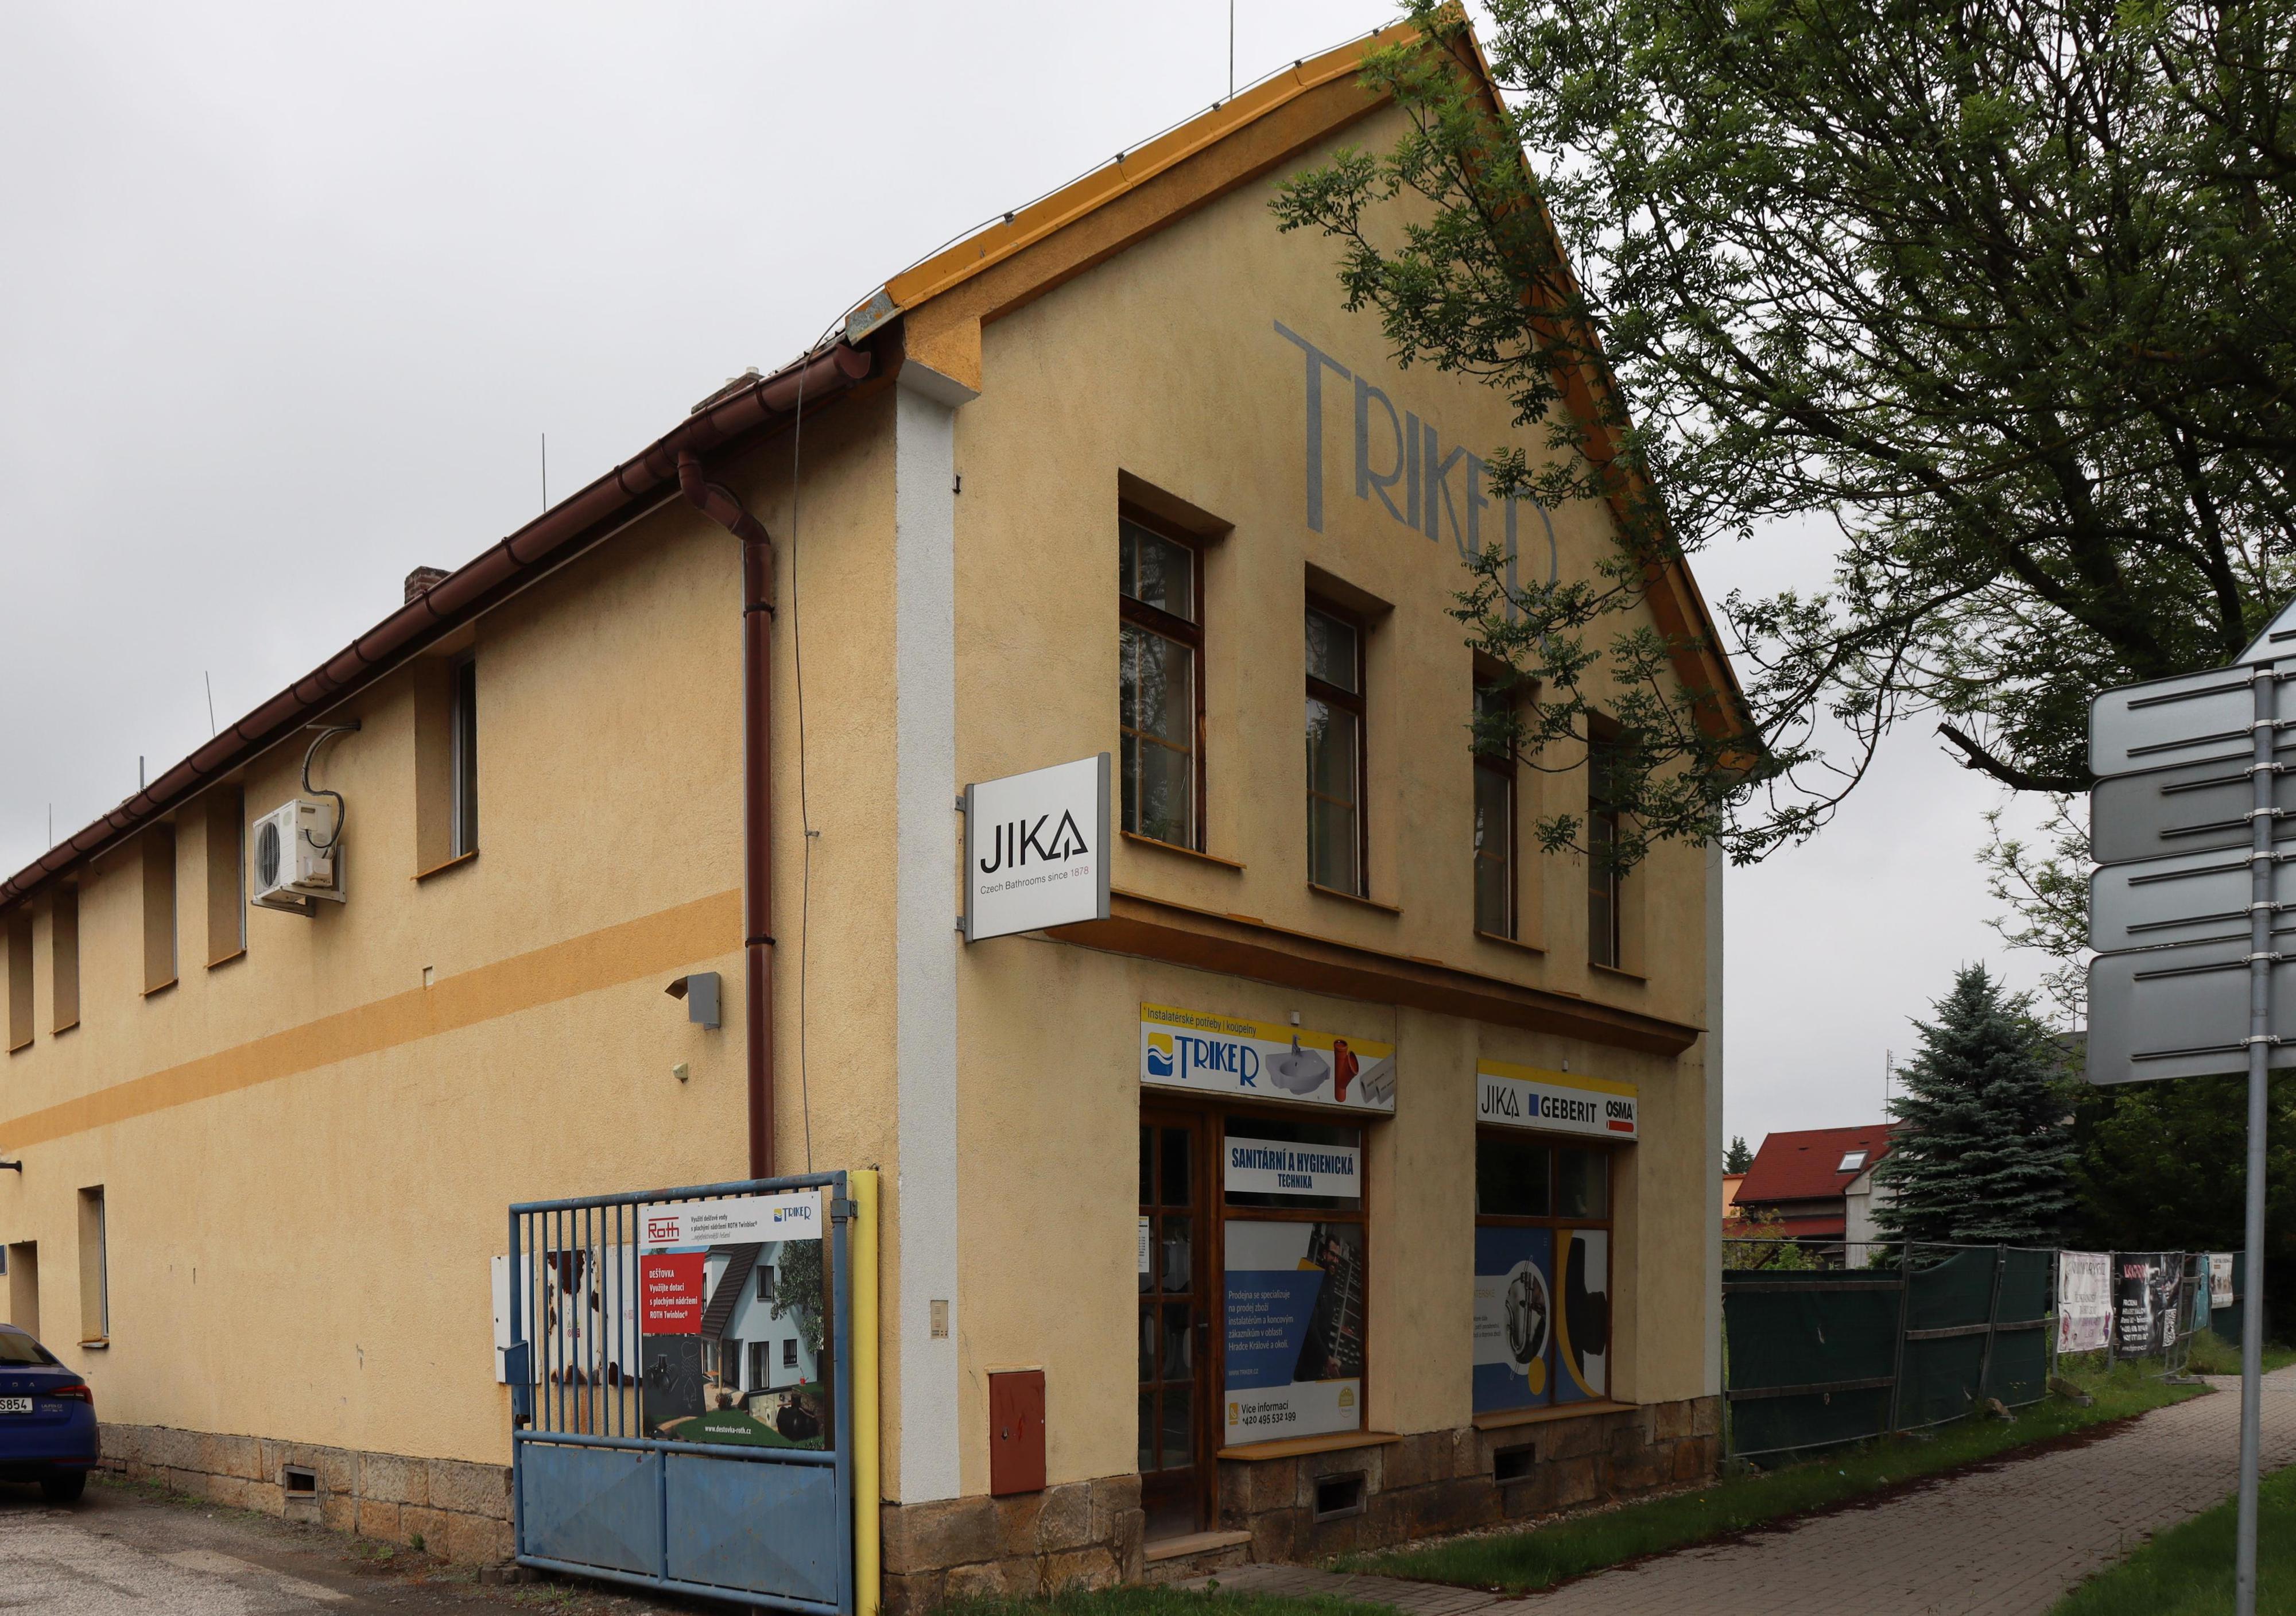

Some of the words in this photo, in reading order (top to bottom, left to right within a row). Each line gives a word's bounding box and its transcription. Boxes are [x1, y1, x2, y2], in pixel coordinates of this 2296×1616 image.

[980, 808, 1088, 874] JIKA
[980, 880, 1003, 894] Czech
[1006, 876, 1046, 890] Bathrooms
[1048, 871, 1068, 882] since
[1071, 866, 1089, 878] 1878
[1148, 1007, 1194, 1025] Instalatérské
[1196, 1017, 1221, 1032] potřeby
[1226, 1021, 1256, 1038] koupelny
[1174, 1035, 1259, 1088] TRIKER
[1481, 1084, 1520, 1119] JIKA
[1541, 1096, 1597, 1123] GEBERIT
[1606, 1100, 1632, 1120] OSMA
[1232, 1146, 1286, 1171] SANITÁRNÍ
[1288, 1152, 1295, 1171] A
[1297, 1152, 1353, 1175] HYGIENICKÁ
[1278, 1173, 1313, 1189] TECHNIKA
[782, 1206, 811, 1222] TRIKER
[648, 1222, 679, 1239] Roth
[694, 1224, 709, 1232] plochými
[649, 1268, 674, 1278] DEŠŤOVKA
[649, 1282, 669, 1293] Využijte
[669, 1282, 684, 1292] dotaci
[1229, 1290, 1252, 1300] Prodejna
[1261, 1289, 1290, 1300] specializuje
[653, 1296, 675, 1307] plochými
[675, 1296, 697, 1305] nádržemi
[1237, 1303, 1254, 1313] prodej
[1255, 1303, 1269, 1312] zboží
[650, 1311, 663, 1319] ROTH
[1229, 1315, 1262, 1326] instalatérům
[1267, 1315, 1294, 1324] koncovým
[1229, 1328, 1260, 1338] zákazníkům
[1265, 1327, 1283, 1336] oblasti
[1229, 1342, 1248, 1351] Hradce
[1250, 1341, 1269, 1350] Králové
[0, 1399, 27, 1410] S854
[1242, 1404, 1256, 1414] Více
[1258, 1400, 1289, 1413] informací
[1242, 1415, 1257, 1426] +420
[1259, 1414, 1271, 1425] 495
[1272, 1413, 1283, 1423] 532
[1285, 1412, 1296, 1421] 199
[704, 1425, 751, 1435] www.destovka-roth.cz
